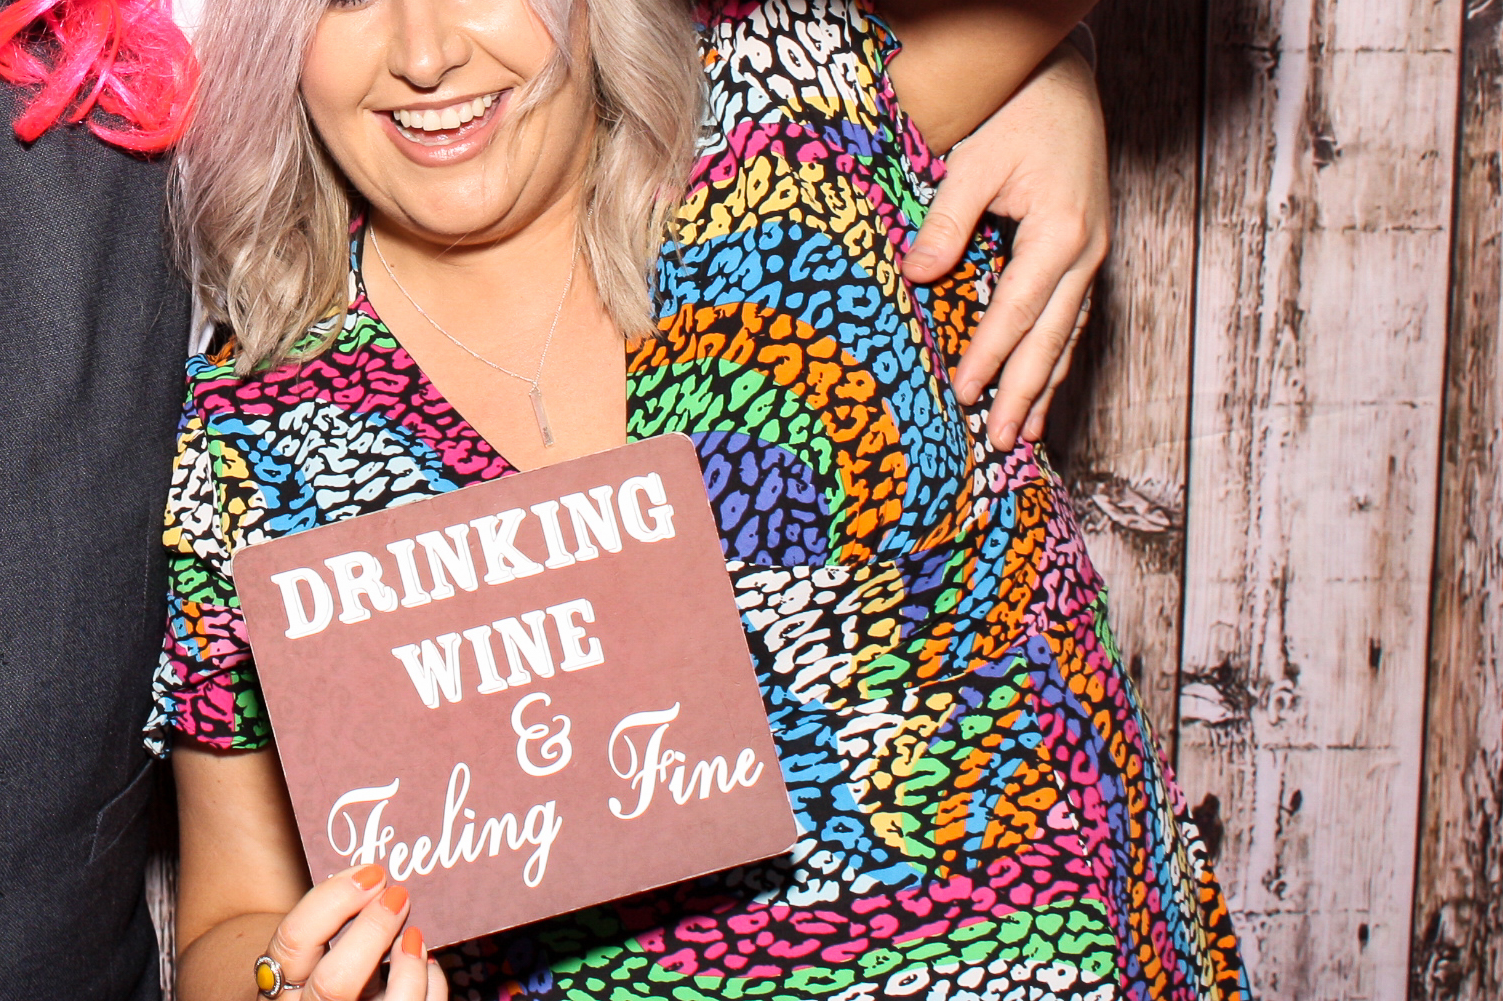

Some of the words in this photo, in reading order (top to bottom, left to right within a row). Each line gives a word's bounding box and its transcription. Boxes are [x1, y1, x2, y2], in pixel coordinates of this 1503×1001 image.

[270, 472, 676, 640] DRINKING
[391, 598, 605, 709] WINE
[326, 762, 563, 888] Feeling
[607, 701, 765, 820] Fine
[510, 691, 573, 777] &
